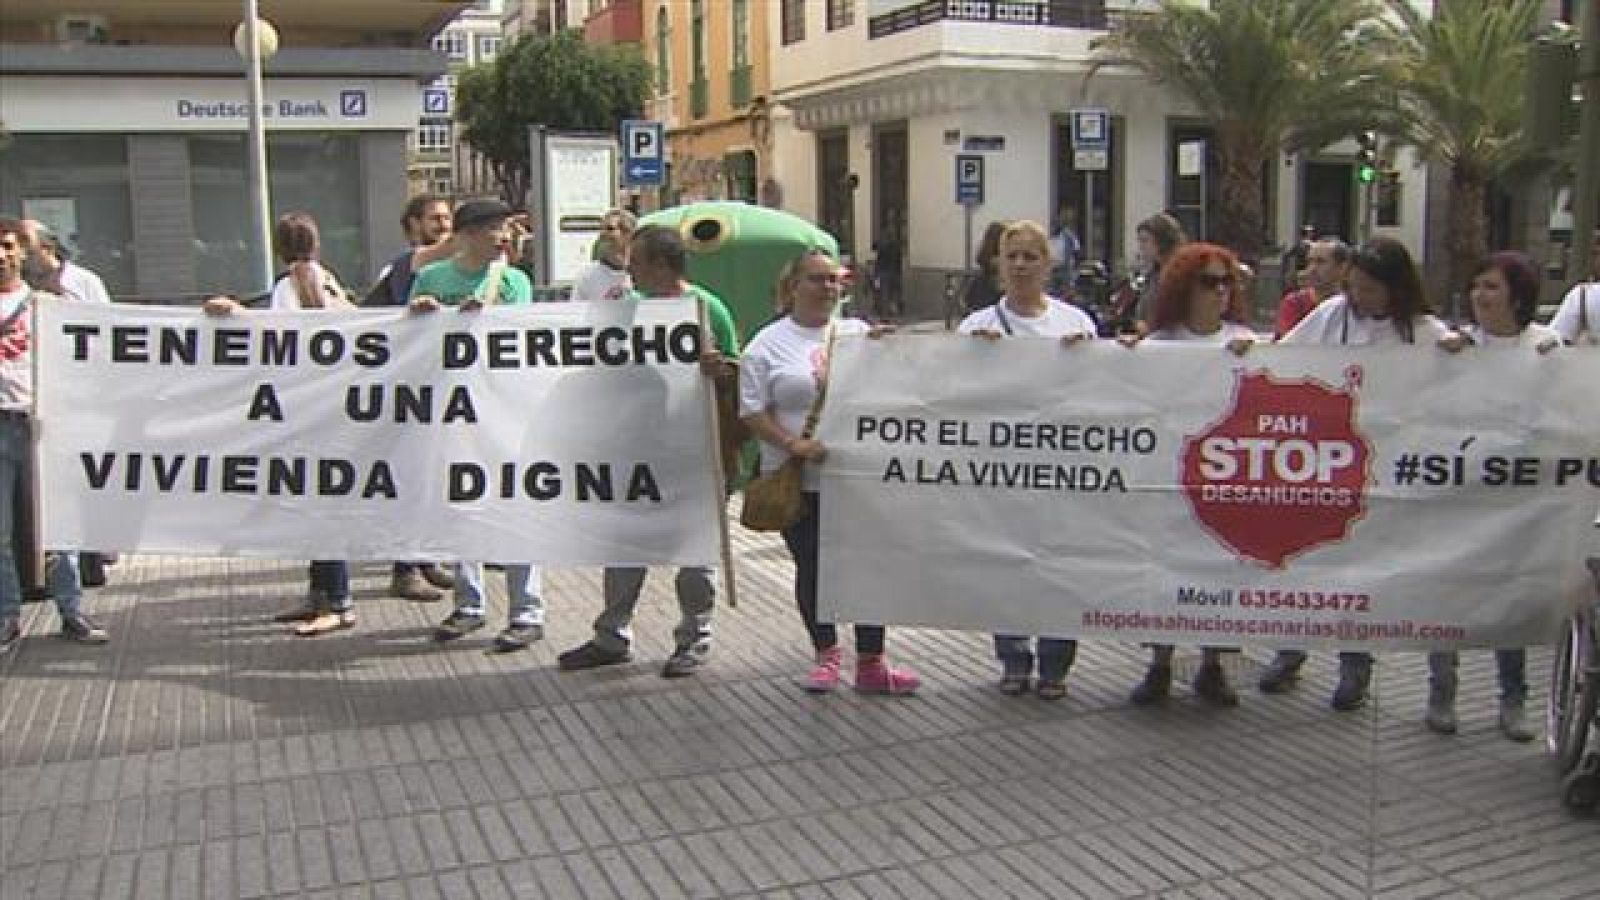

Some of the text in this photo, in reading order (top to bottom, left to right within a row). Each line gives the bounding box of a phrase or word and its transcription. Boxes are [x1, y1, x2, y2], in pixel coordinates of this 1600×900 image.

[177, 100, 328, 117] Deutsce Bank
[635, 131, 651, 155] P
[964, 162, 976, 177] P
[63, 323, 391, 367] TENEMOS
[442, 321, 701, 370] DERECHO
[247, 384, 478, 424] A UNA
[857, 416, 1157, 453] POR EL DERECHO
[1258, 414, 1308, 433] PAH
[882, 457, 1128, 493] A LA VIVIENDA
[1199, 437, 1354, 483] STOP
[1395, 436, 1476, 486] #SÍ
[1482, 456, 1540, 487] SE
[81, 452, 663, 503] VIVIENDA DIGNA
[1202, 485, 1354, 506] DESAHUCIOS
[1177, 586, 1371, 611] Móvil 635433472
[1081, 609, 1466, 641] stopdesahucioscanarias@gmail.com
